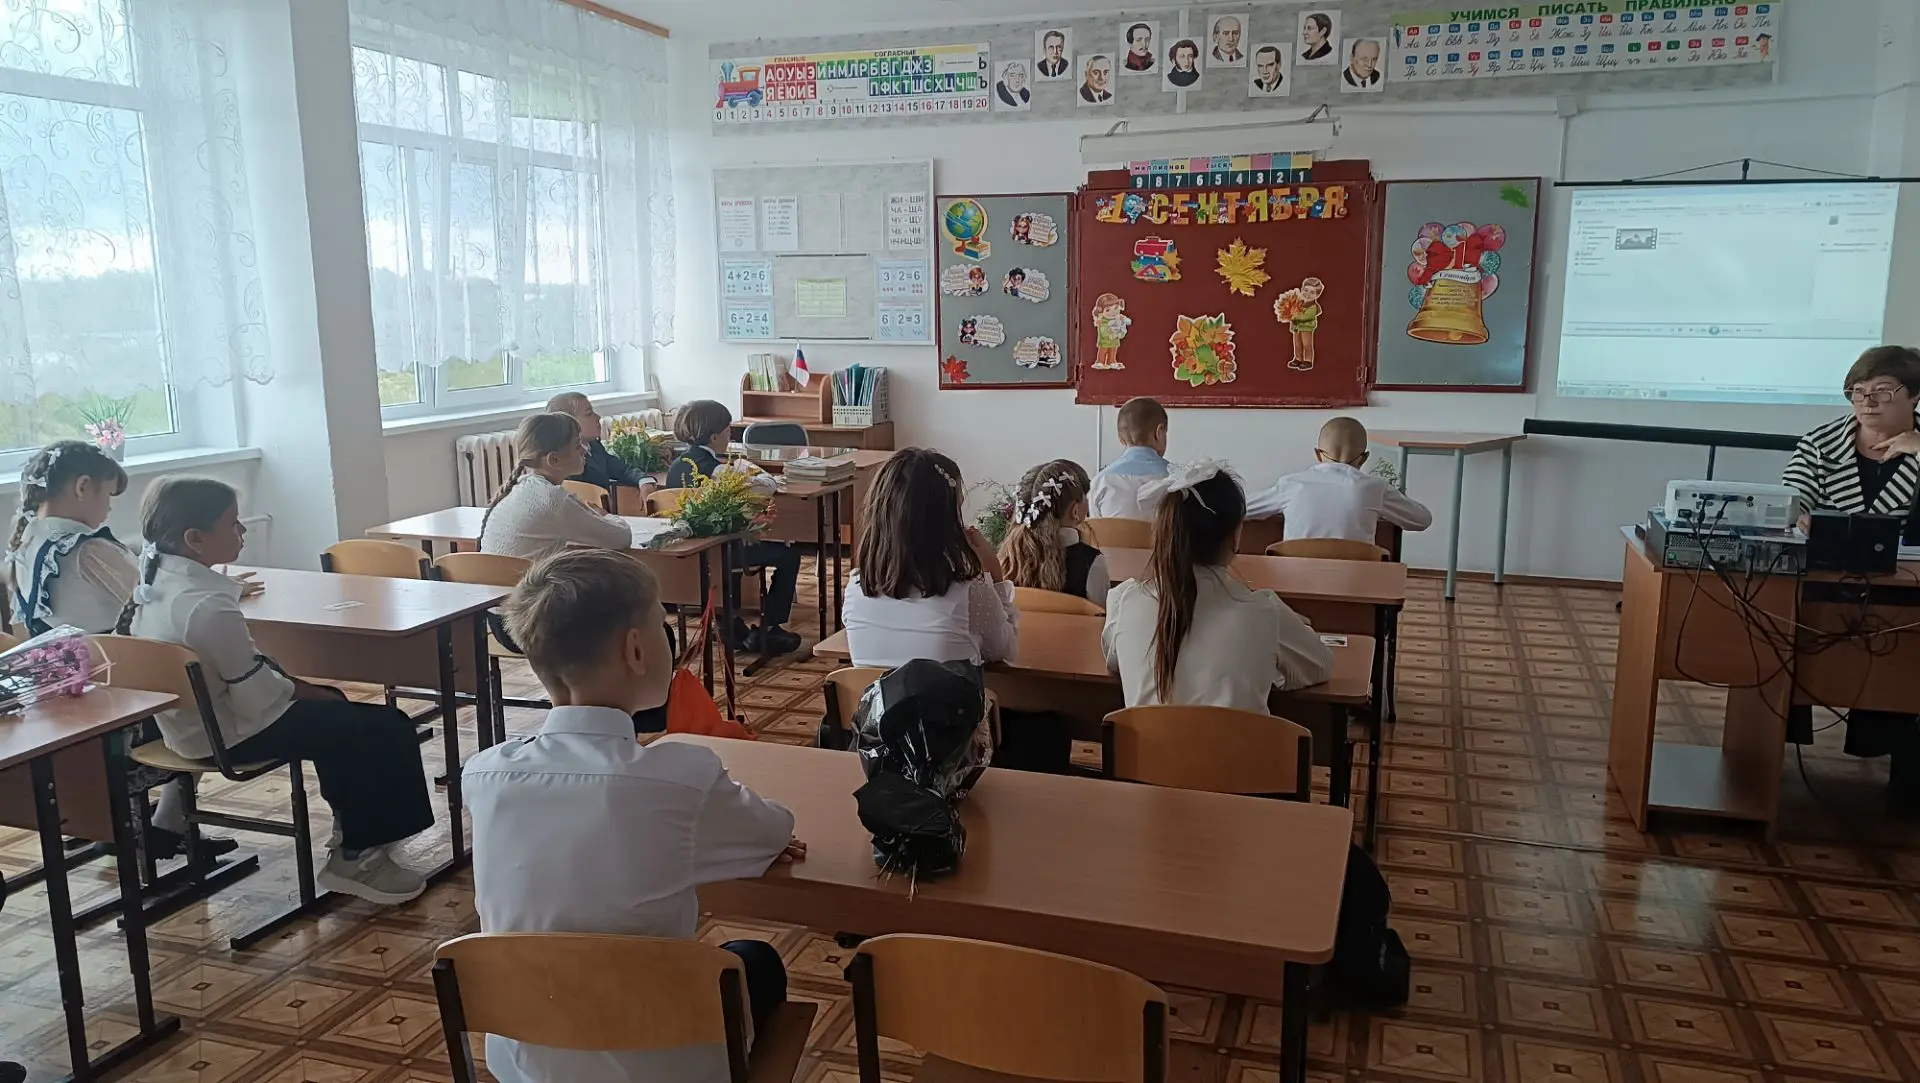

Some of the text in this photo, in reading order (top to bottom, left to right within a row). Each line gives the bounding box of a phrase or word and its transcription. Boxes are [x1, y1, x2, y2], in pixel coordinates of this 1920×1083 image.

[1451, 8, 1519, 21] УЧИМСЯ
[1538, 2, 1608, 16] ПИСАТЬ
[742, 111, 747, 119] 2
[754, 110, 759, 118] 3
[767, 110, 772, 118] 4
[780, 109, 784, 117] 5
[792, 108, 797, 116] 6
[805, 107, 810, 116] 7
[818, 107, 823, 115] 8
[831, 106, 836, 114] 9
[842, 105, 851, 113] 10
[856, 105, 864, 113] 11
[869, 104, 878, 113] 12
[882, 104, 891, 112] 13
[895, 103, 904, 112] 14
[908, 102, 918, 111] 15
[922, 102, 932, 110] 16
[935, 101, 945, 109] 17
[949, 100, 958, 109] 18
[963, 100, 972, 108] 19
[976, 99, 987, 107] 20
[1136, 171, 1304, 188] 9 8 7 6 5 4 3 2 1
[1096, 186, 1346, 225] 1 СЕНТЯБРЯ
